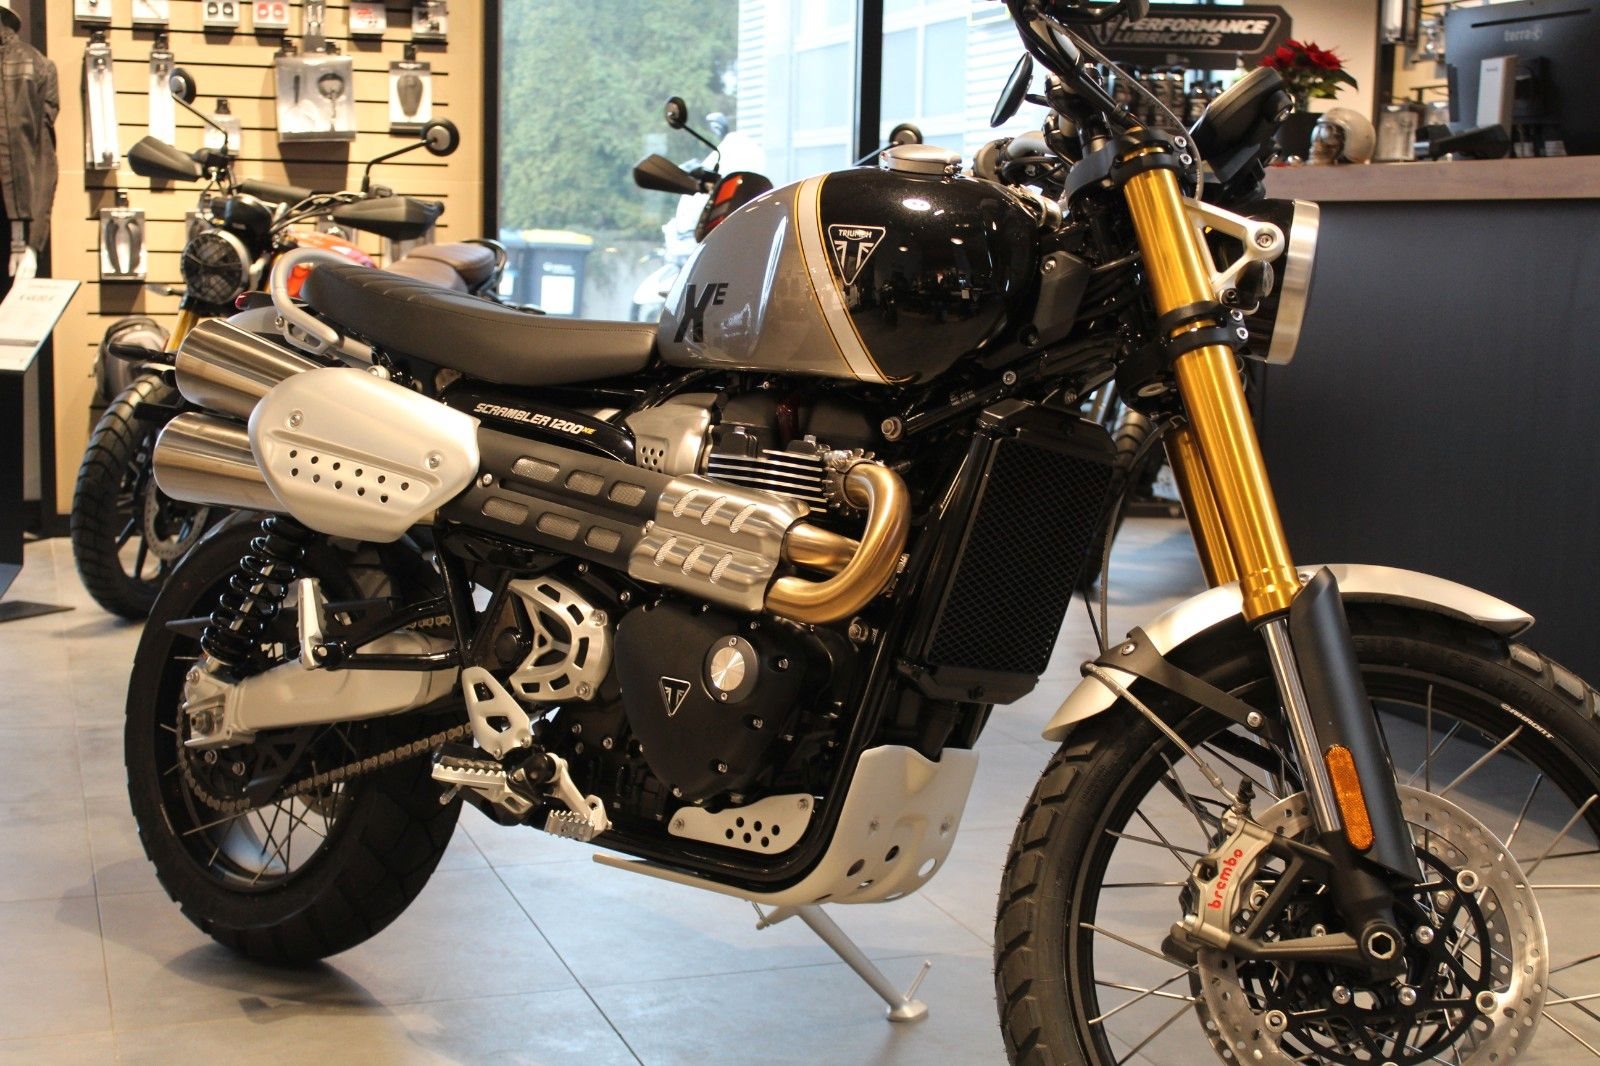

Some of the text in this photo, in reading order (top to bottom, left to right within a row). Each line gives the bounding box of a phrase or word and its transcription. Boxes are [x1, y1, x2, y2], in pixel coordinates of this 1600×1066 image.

[1114, 31, 1223, 45] LUBRICANTS
[838, 229, 873, 239] TRIUMPH
[473, 402, 552, 426] SCRAMBLER
[1207, 848, 1244, 910] brembo
